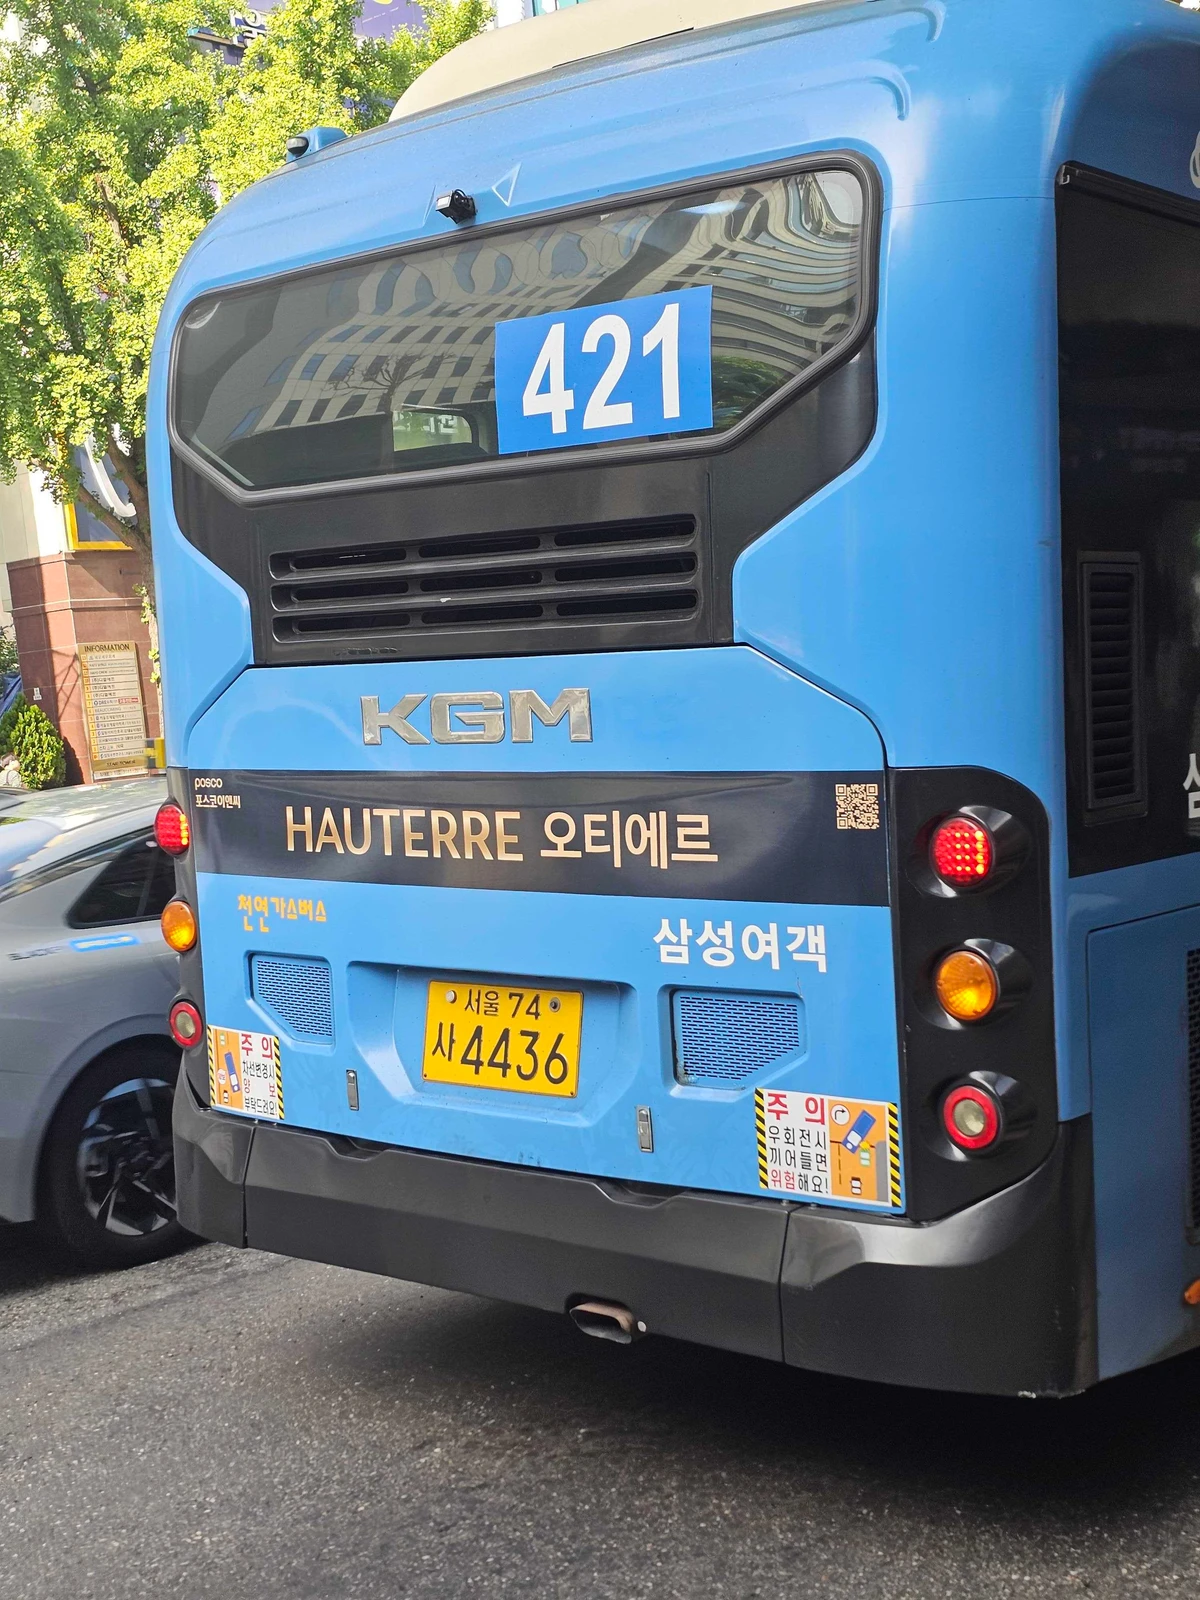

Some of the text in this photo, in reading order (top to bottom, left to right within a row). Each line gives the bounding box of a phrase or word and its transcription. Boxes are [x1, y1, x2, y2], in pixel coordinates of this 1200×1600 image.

[522, 302, 680, 434] 421
[84, 643, 130, 653] INFORMATION
[360, 688, 594, 745] KGM
[194, 777, 223, 790] posco
[195, 794, 241, 809] 포스코이앤씨
[285, 805, 719, 870] HAUTERRE 오티에르
[237, 894, 327, 933] 천연가스버스
[653, 918, 828, 973] 삼성여객
[464, 988, 541, 1021] 서울 74
[768, 1125, 827, 1151] 우회전시
[769, 1147, 828, 1173] 끼어들면
[771, 1169, 829, 1194] 위험해요!
